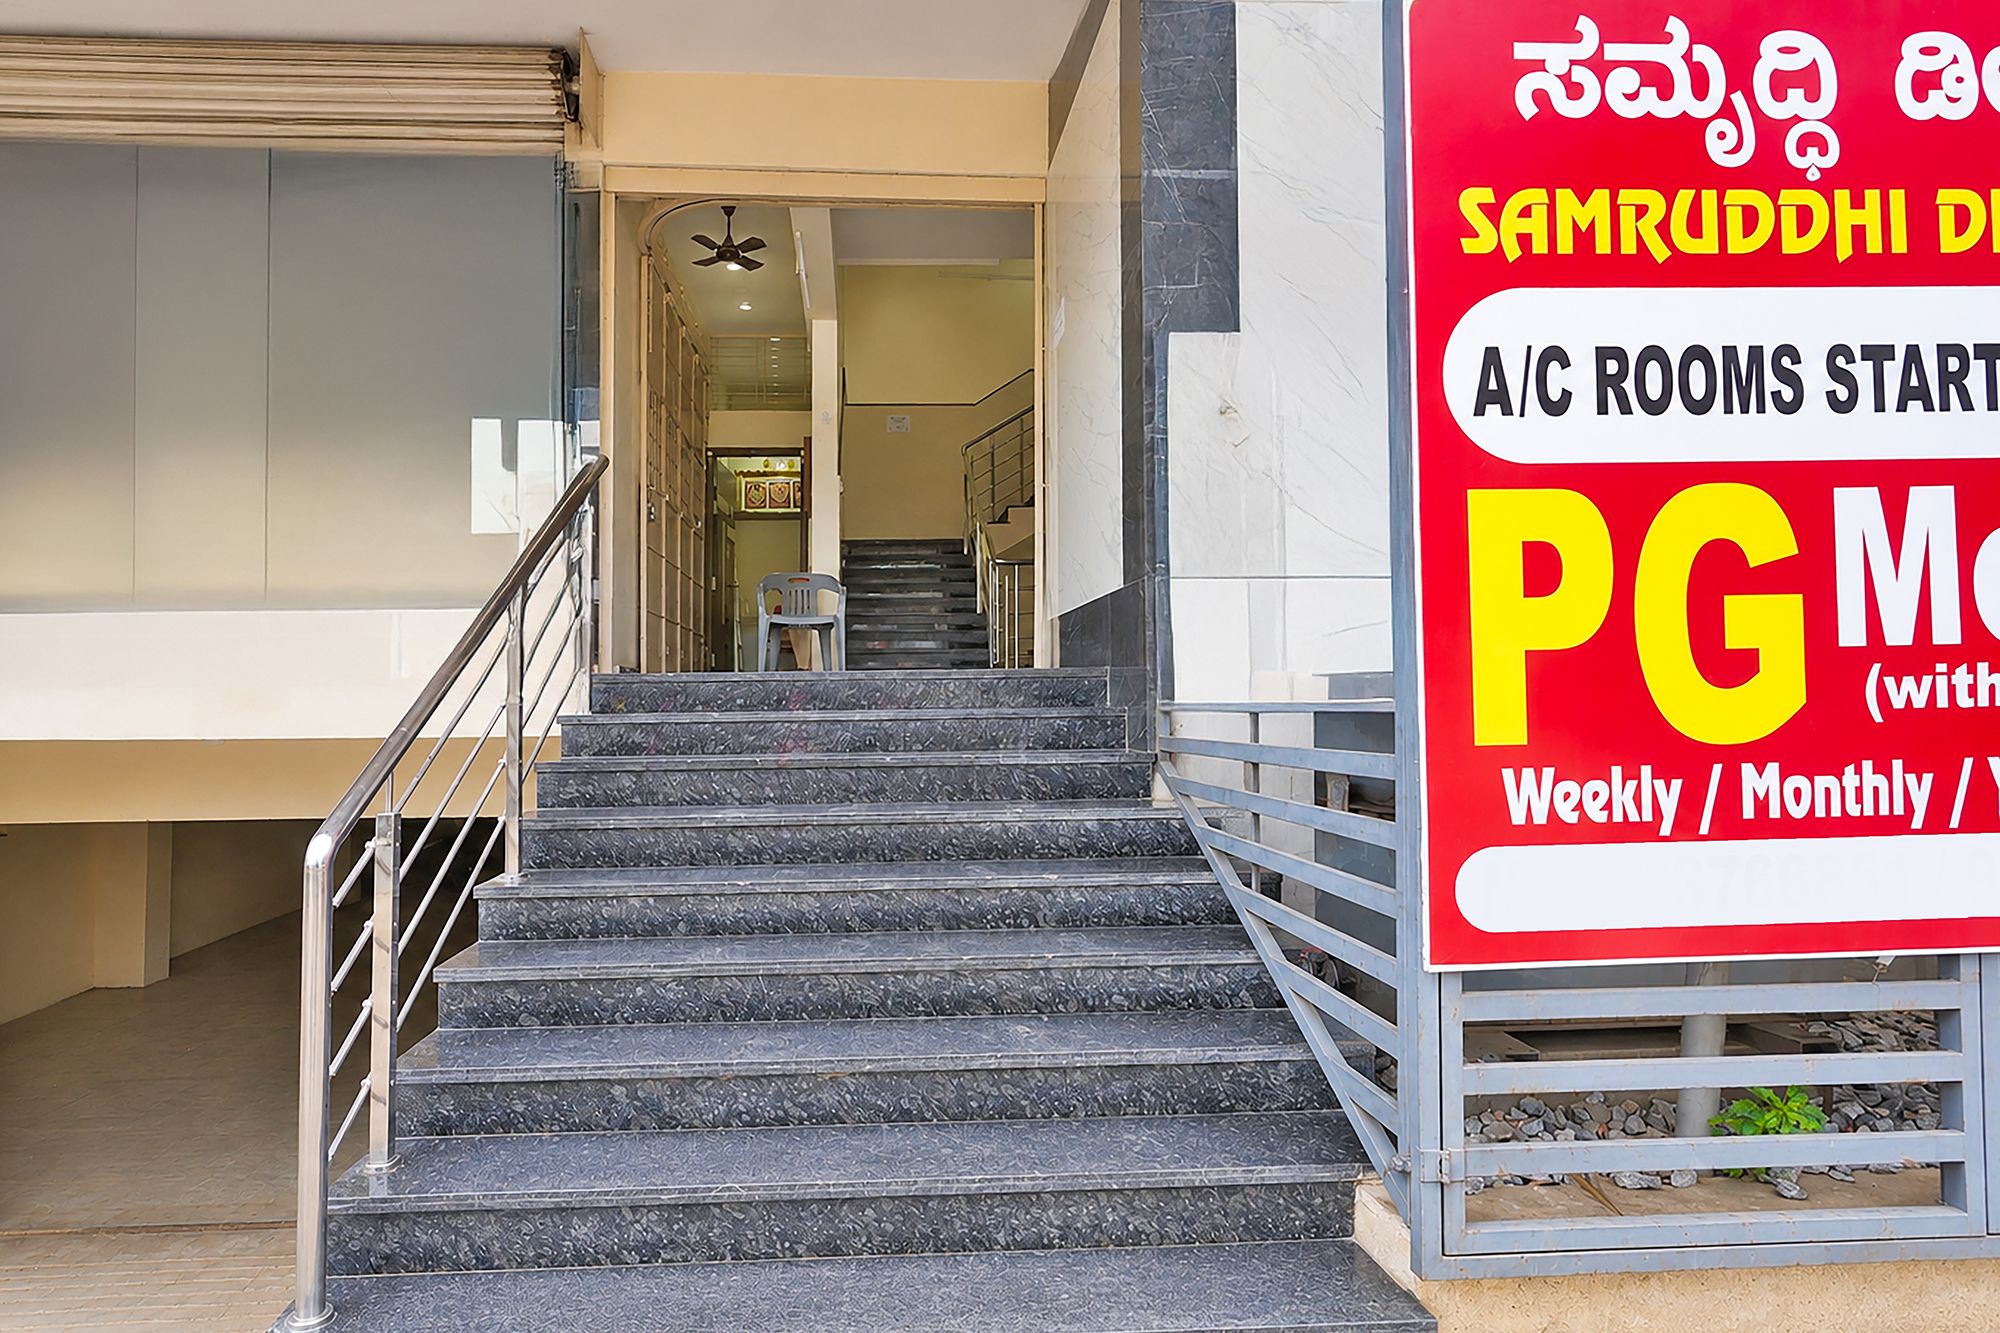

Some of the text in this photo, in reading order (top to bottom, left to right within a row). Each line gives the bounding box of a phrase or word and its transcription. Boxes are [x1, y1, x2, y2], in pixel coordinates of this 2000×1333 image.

[1513, 15, 1841, 182] ಸಮೃದ್ಧಿ
[1458, 186, 1908, 265] SAMRUDDHI
[1473, 342, 2000, 418] A/C ROOMS START
[1466, 482, 1807, 746] PG
[1501, 764, 1683, 837] Weekly
[1740, 758, 1934, 830] Monthly
